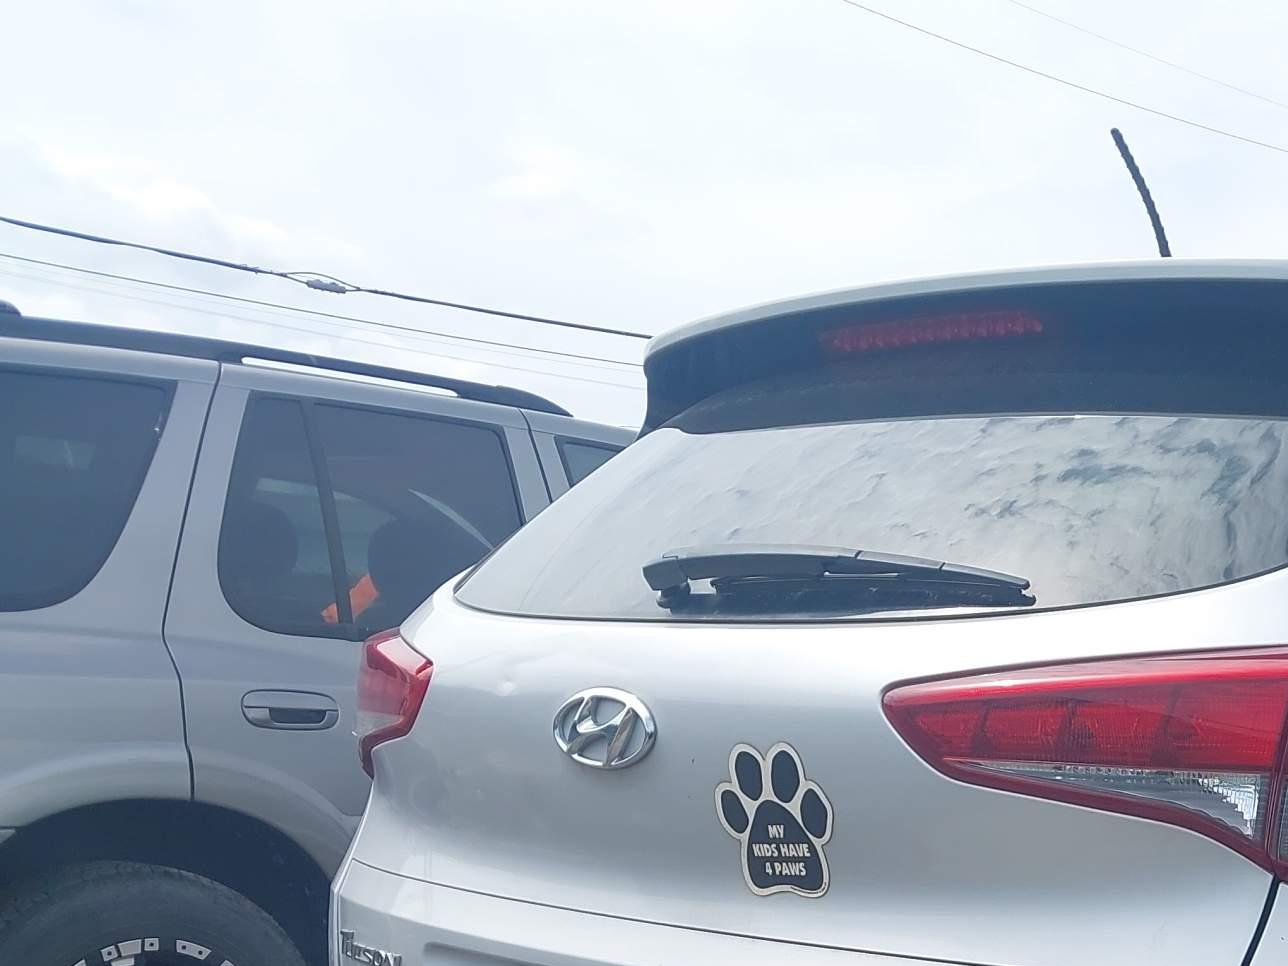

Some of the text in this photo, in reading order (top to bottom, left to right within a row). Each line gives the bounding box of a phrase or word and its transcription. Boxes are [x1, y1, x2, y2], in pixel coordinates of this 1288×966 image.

[767, 824, 785, 839] MY
[751, 843, 811, 857] KIDS HAVE
[765, 861, 807, 876] 4 PAWS
